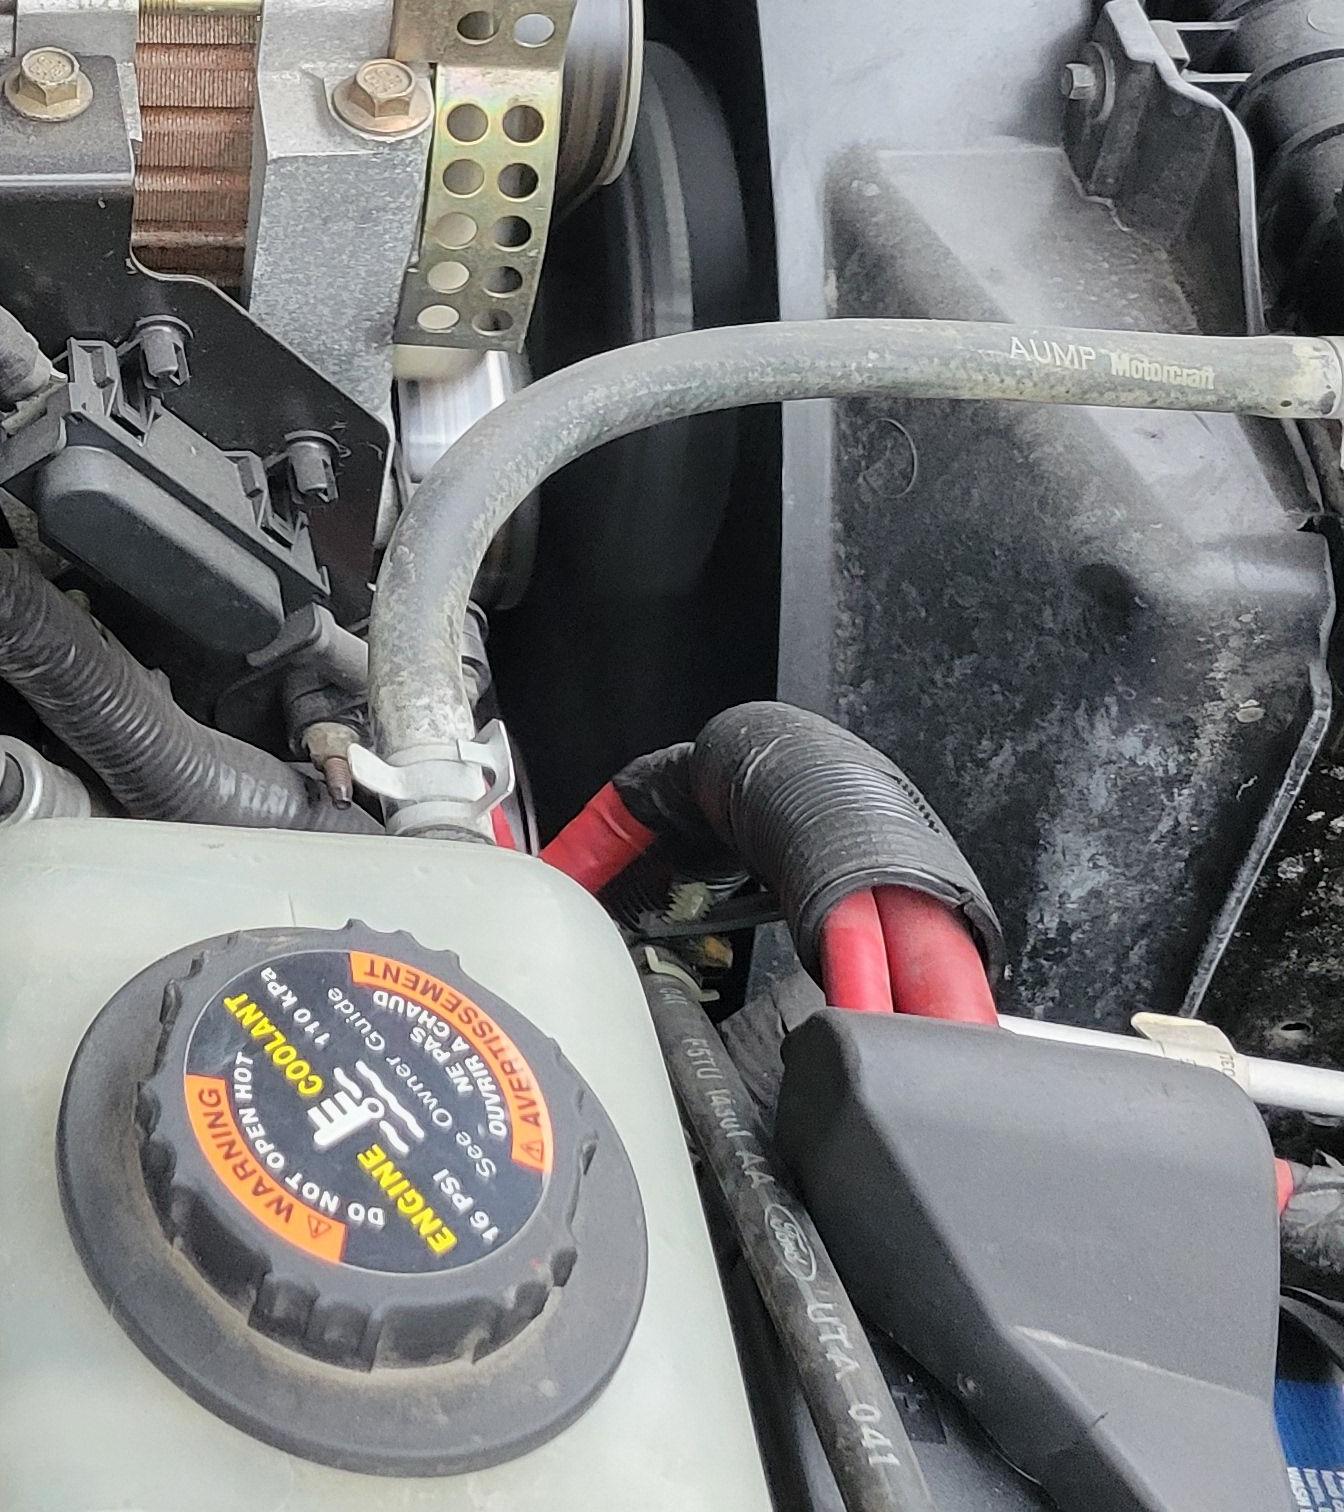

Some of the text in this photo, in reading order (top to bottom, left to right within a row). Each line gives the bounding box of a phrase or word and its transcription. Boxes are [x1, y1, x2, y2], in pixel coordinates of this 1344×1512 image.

[1009, 336, 1215, 390] AUMP Motorcraft
[327, 986, 497, 1178] See Owner Guide
[363, 958, 542, 1129] AVERTISSEMENT
[372, 989, 450, 1038] CHAUD
[409, 1026, 475, 1094] NE PAS
[464, 1053, 508, 1138] OUVRIR
[197, 1087, 295, 1225] WARNING
[222, 992, 459, 1255] ENGINE COOLANT
[233, 1050, 386, 1229] DO NOT OPEN HOT
[260, 966, 500, 1242] 16 PSI 110 kPa
[806, 1301, 861, 1382] UTA
[847, 1403, 901, 1467] 041
